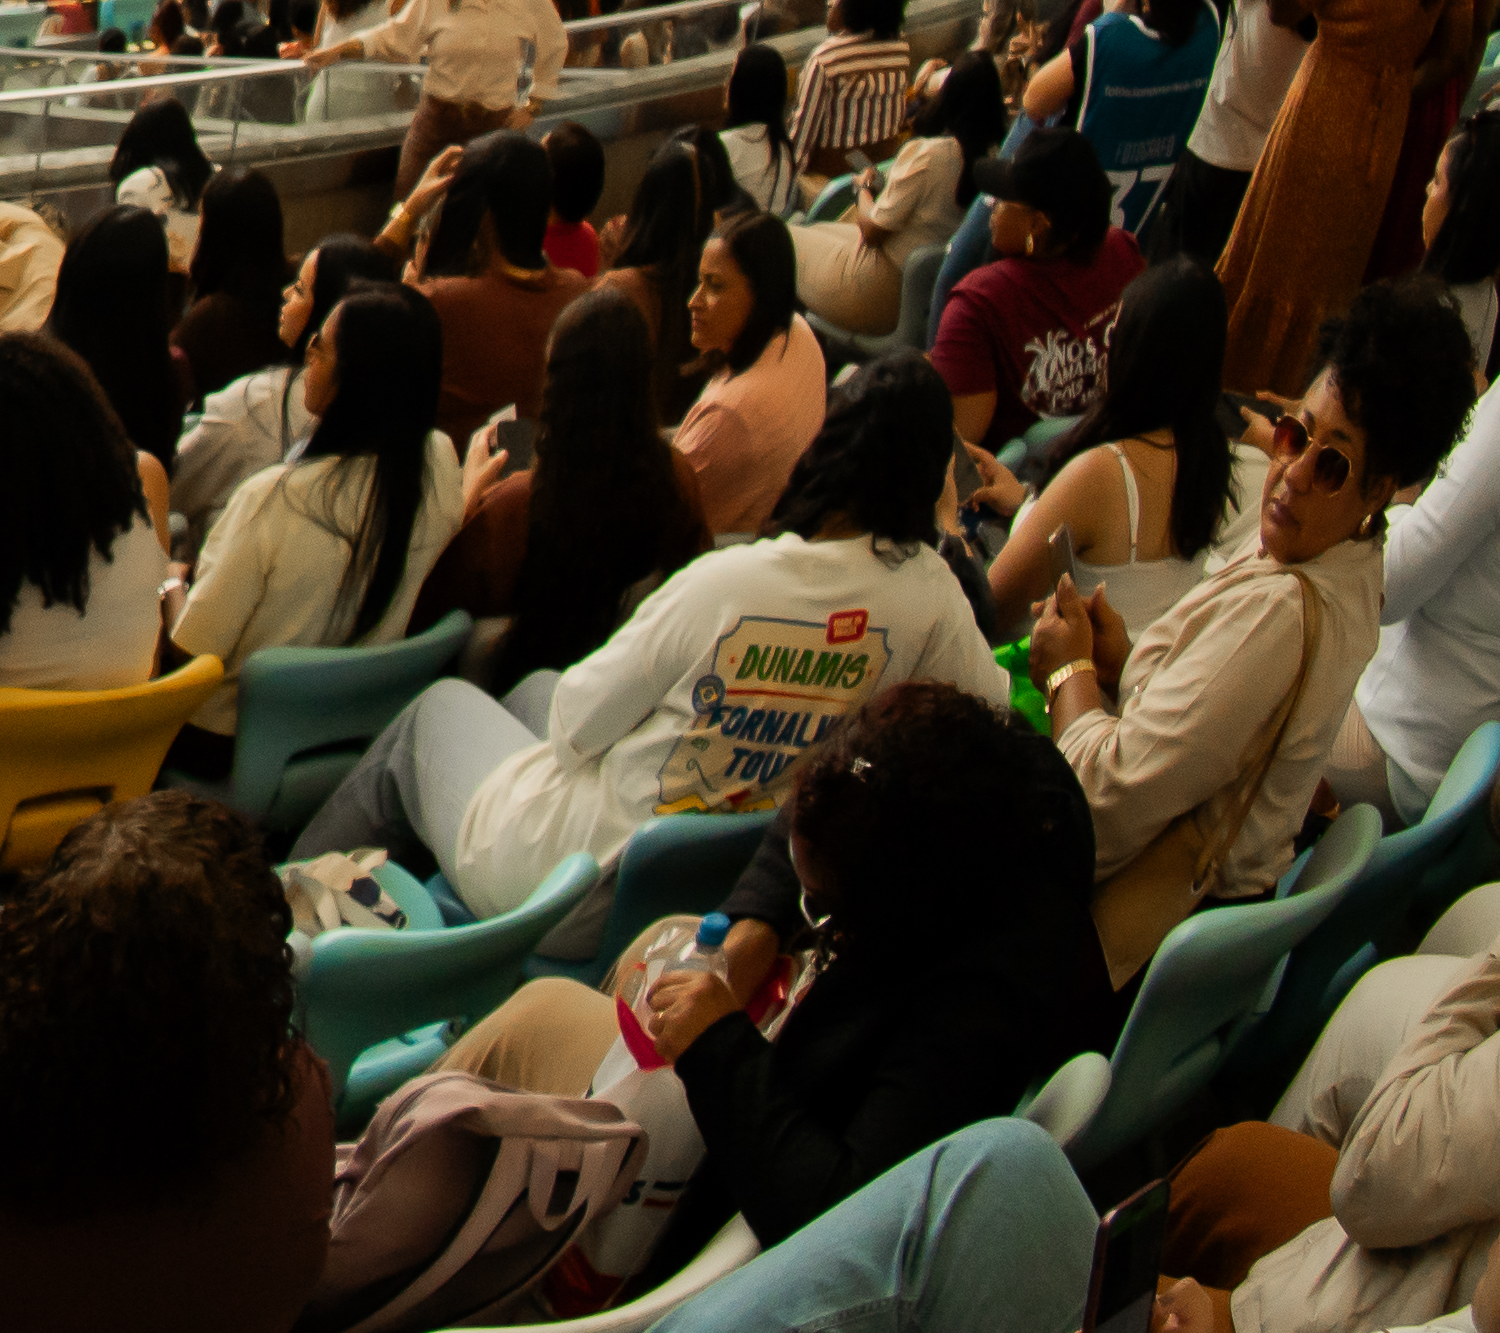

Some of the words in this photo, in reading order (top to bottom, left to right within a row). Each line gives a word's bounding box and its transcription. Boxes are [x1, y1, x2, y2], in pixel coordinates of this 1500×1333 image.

[735, 644, 870, 689] DUNAMIS
[706, 704, 843, 749] FORNAL
[724, 746, 797, 785] TOU
